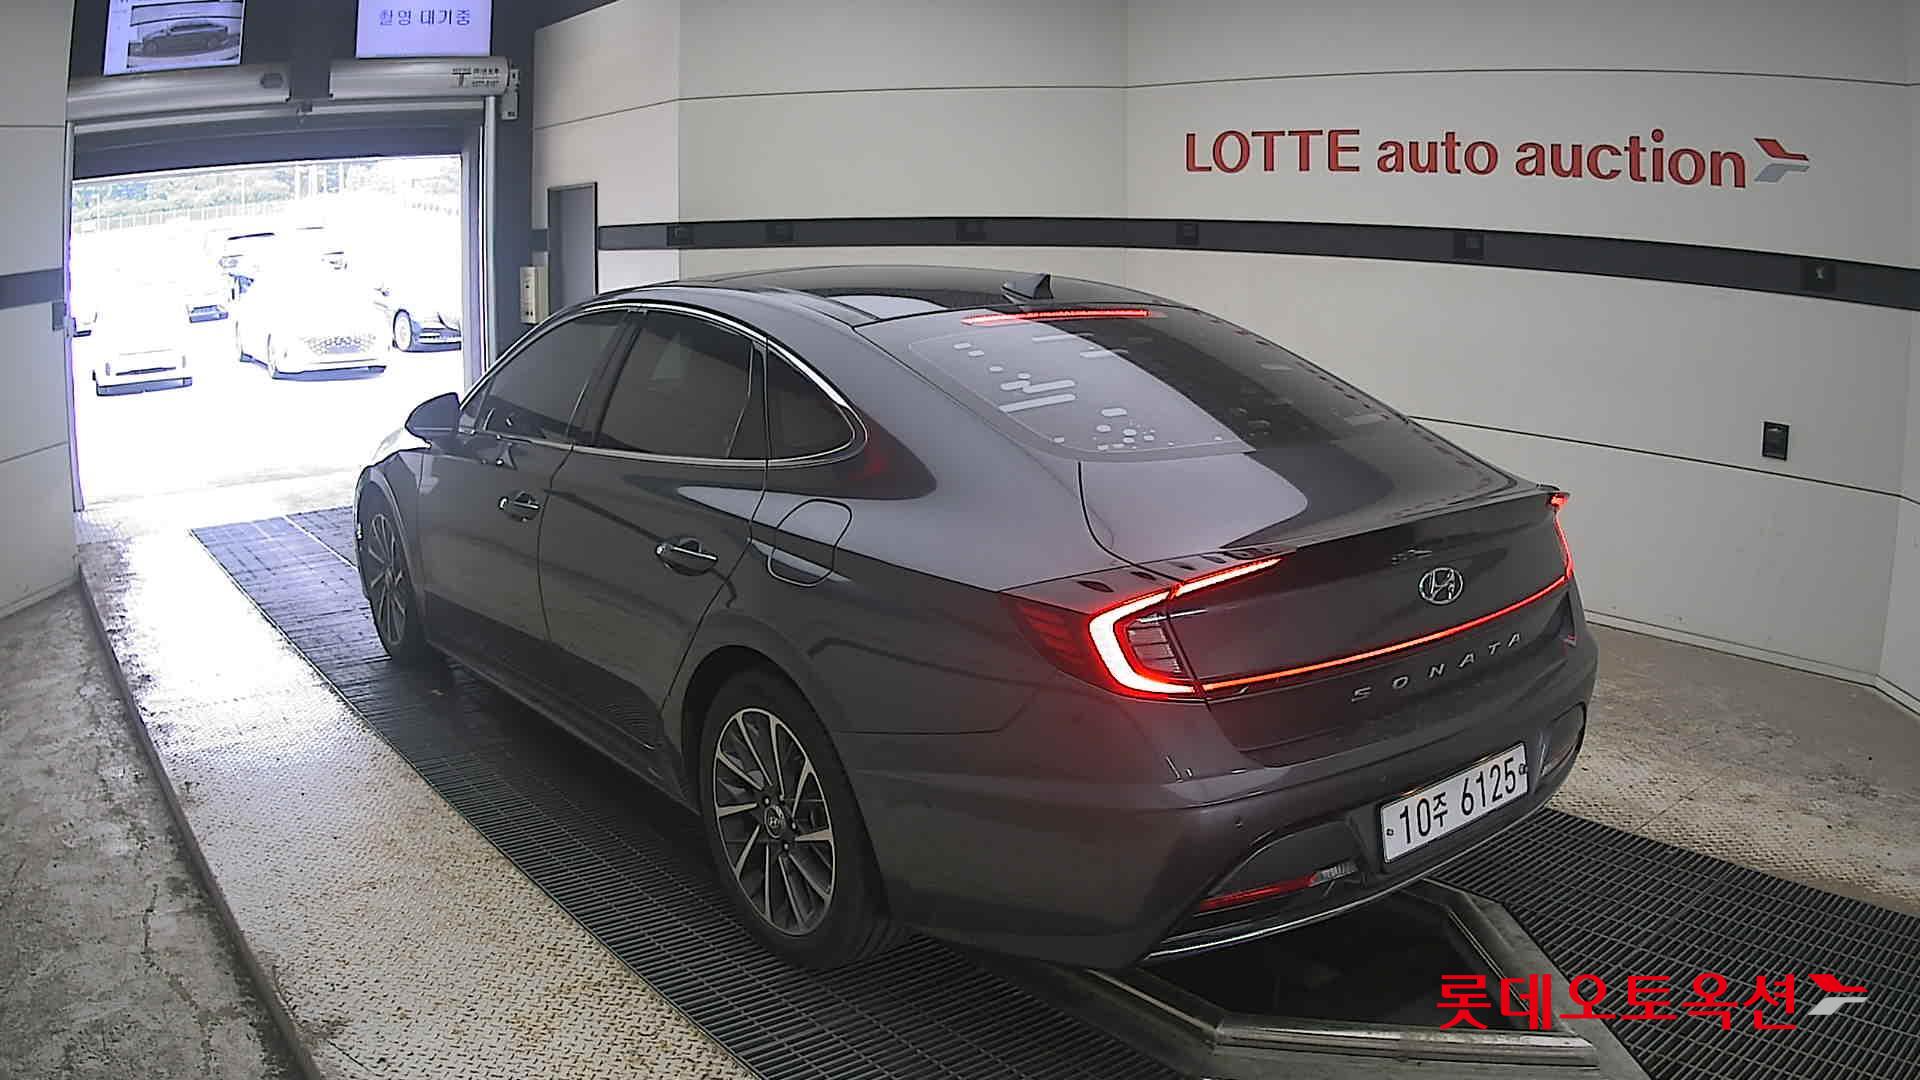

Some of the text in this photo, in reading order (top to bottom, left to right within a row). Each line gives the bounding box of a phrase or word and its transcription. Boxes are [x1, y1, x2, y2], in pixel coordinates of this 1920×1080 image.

[420, 8, 471, 26] 대기중
[1185, 128, 1747, 188] LOTTE auto auction
[1351, 632, 1522, 702] SONATA
[1399, 757, 1516, 844] 10주 6125
